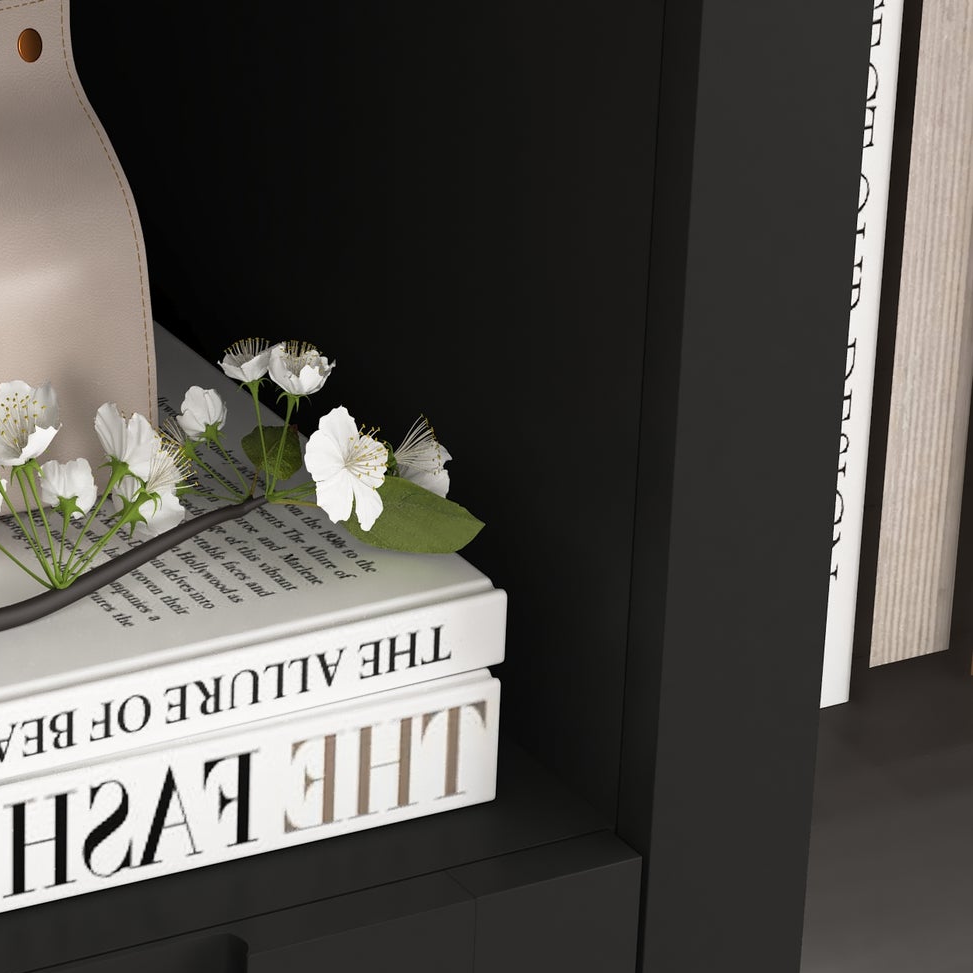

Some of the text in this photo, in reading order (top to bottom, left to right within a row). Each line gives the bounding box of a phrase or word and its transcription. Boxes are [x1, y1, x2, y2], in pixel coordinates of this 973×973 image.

[226, 537, 248, 545] of
[238, 547, 261, 561] this
[260, 563, 298, 590] vibrant
[257, 537, 288, 551] and
[280, 554, 324, 584] Marlene
[284, 528, 306, 543] The
[302, 546, 338, 568] Allure
[335, 571, 358, 579] of
[301, 517, 323, 529] the
[342, 550, 359, 558] to
[355, 560, 377, 572] the
[162, 569, 196, 592] delves
[190, 593, 216, 609] into
[176, 551, 238, 594] Hollywood
[228, 595, 244, 603] as
[222, 561, 252, 580] faces
[245, 582, 275, 597] and
[113, 613, 135, 626] the
[161, 596, 190, 614] their
[359, 625, 452, 679] THE
[166, 650, 346, 723] ALLURE
[90, 694, 153, 740] OF
